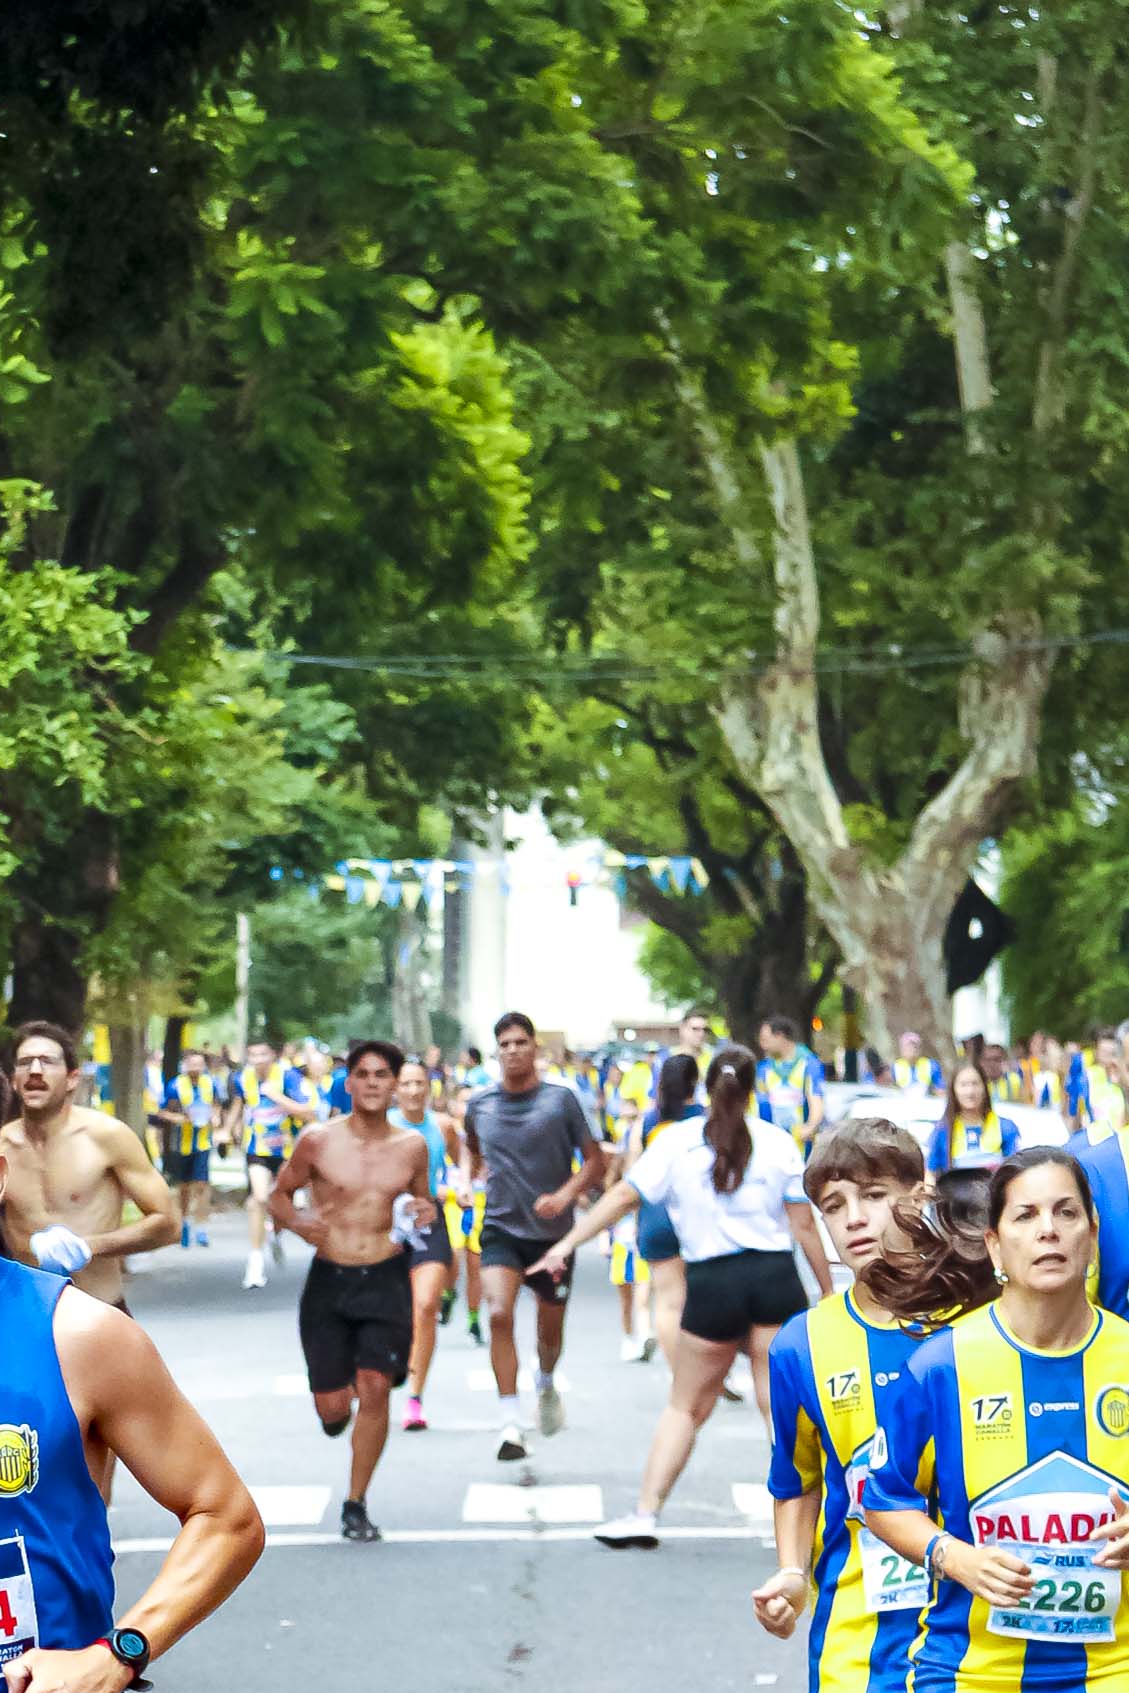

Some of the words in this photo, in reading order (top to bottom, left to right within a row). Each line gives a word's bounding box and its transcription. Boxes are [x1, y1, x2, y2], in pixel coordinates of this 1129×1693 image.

[826, 1371, 856, 1398] 17
[972, 1396, 1008, 1421] 17
[975, 1513, 1116, 1544] PALADI
[1055, 1555, 1085, 1567] RUS
[1019, 1579, 1106, 1613] 226
